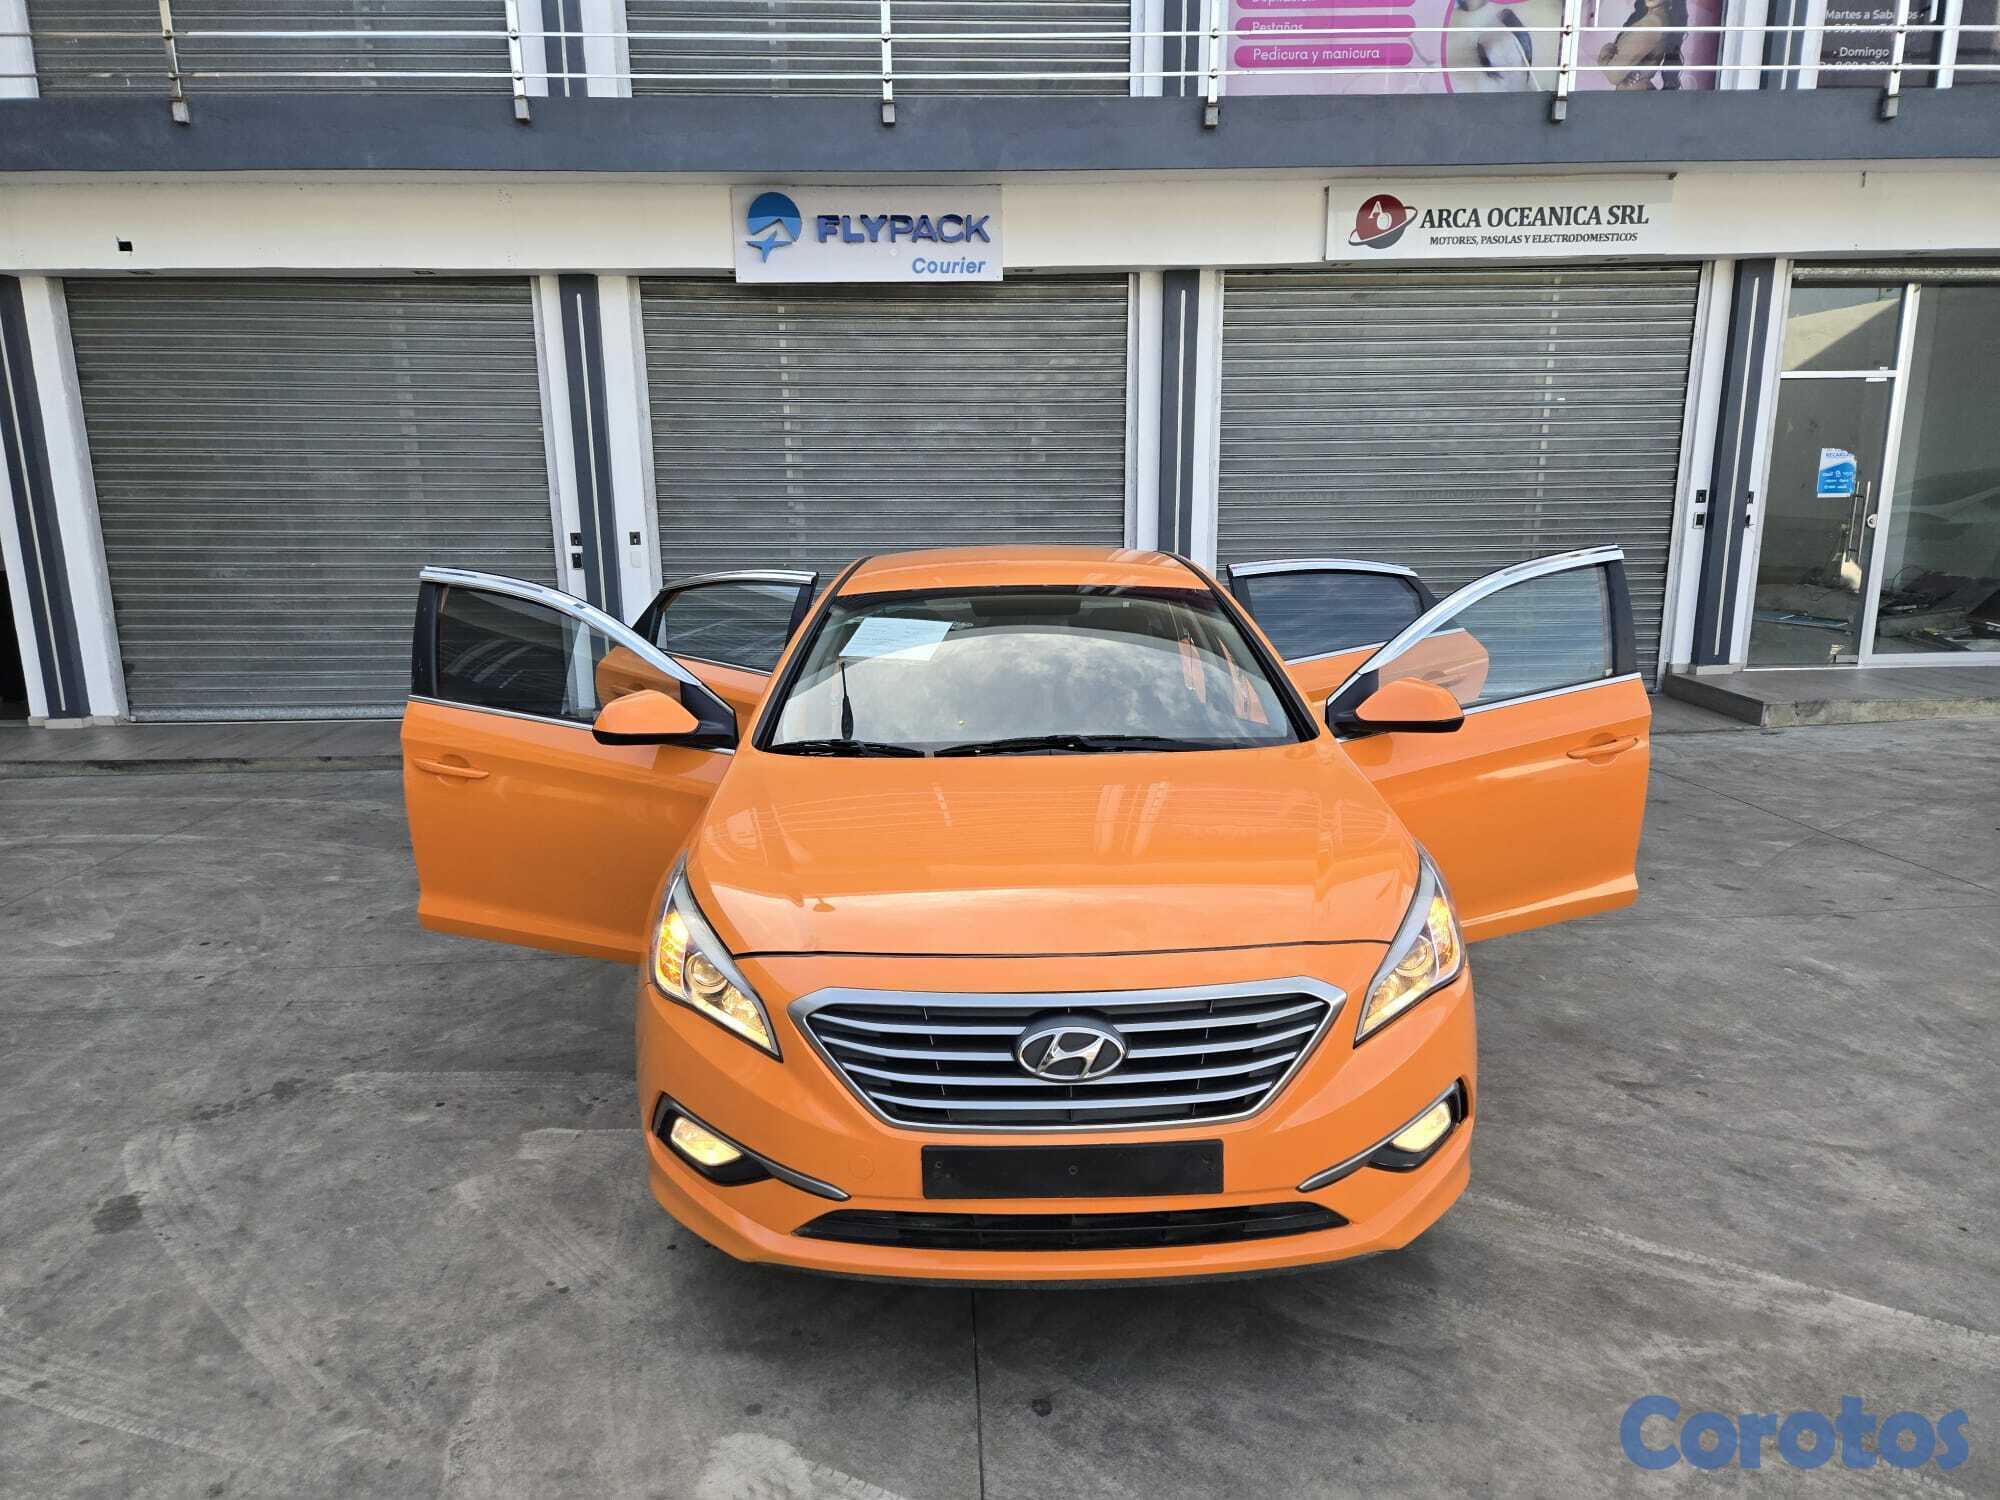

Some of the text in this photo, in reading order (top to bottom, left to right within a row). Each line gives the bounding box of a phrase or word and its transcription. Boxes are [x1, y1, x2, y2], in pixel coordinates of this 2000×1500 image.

[1825, 10, 1861, 19] Martes
[1864, 11, 1870, 19] a
[1253, 47, 1380, 64] Pedicura y manicura
[1839, 46, 1889, 58] Domingo
[1420, 204, 1649, 228] ARCA OCEANICA SRL
[816, 214, 991, 243] FLYPACK
[1430, 232, 1638, 246] MOTORES, PASOLAS Y ELECTRODOMESTICOS
[912, 257, 986, 274] Courier
